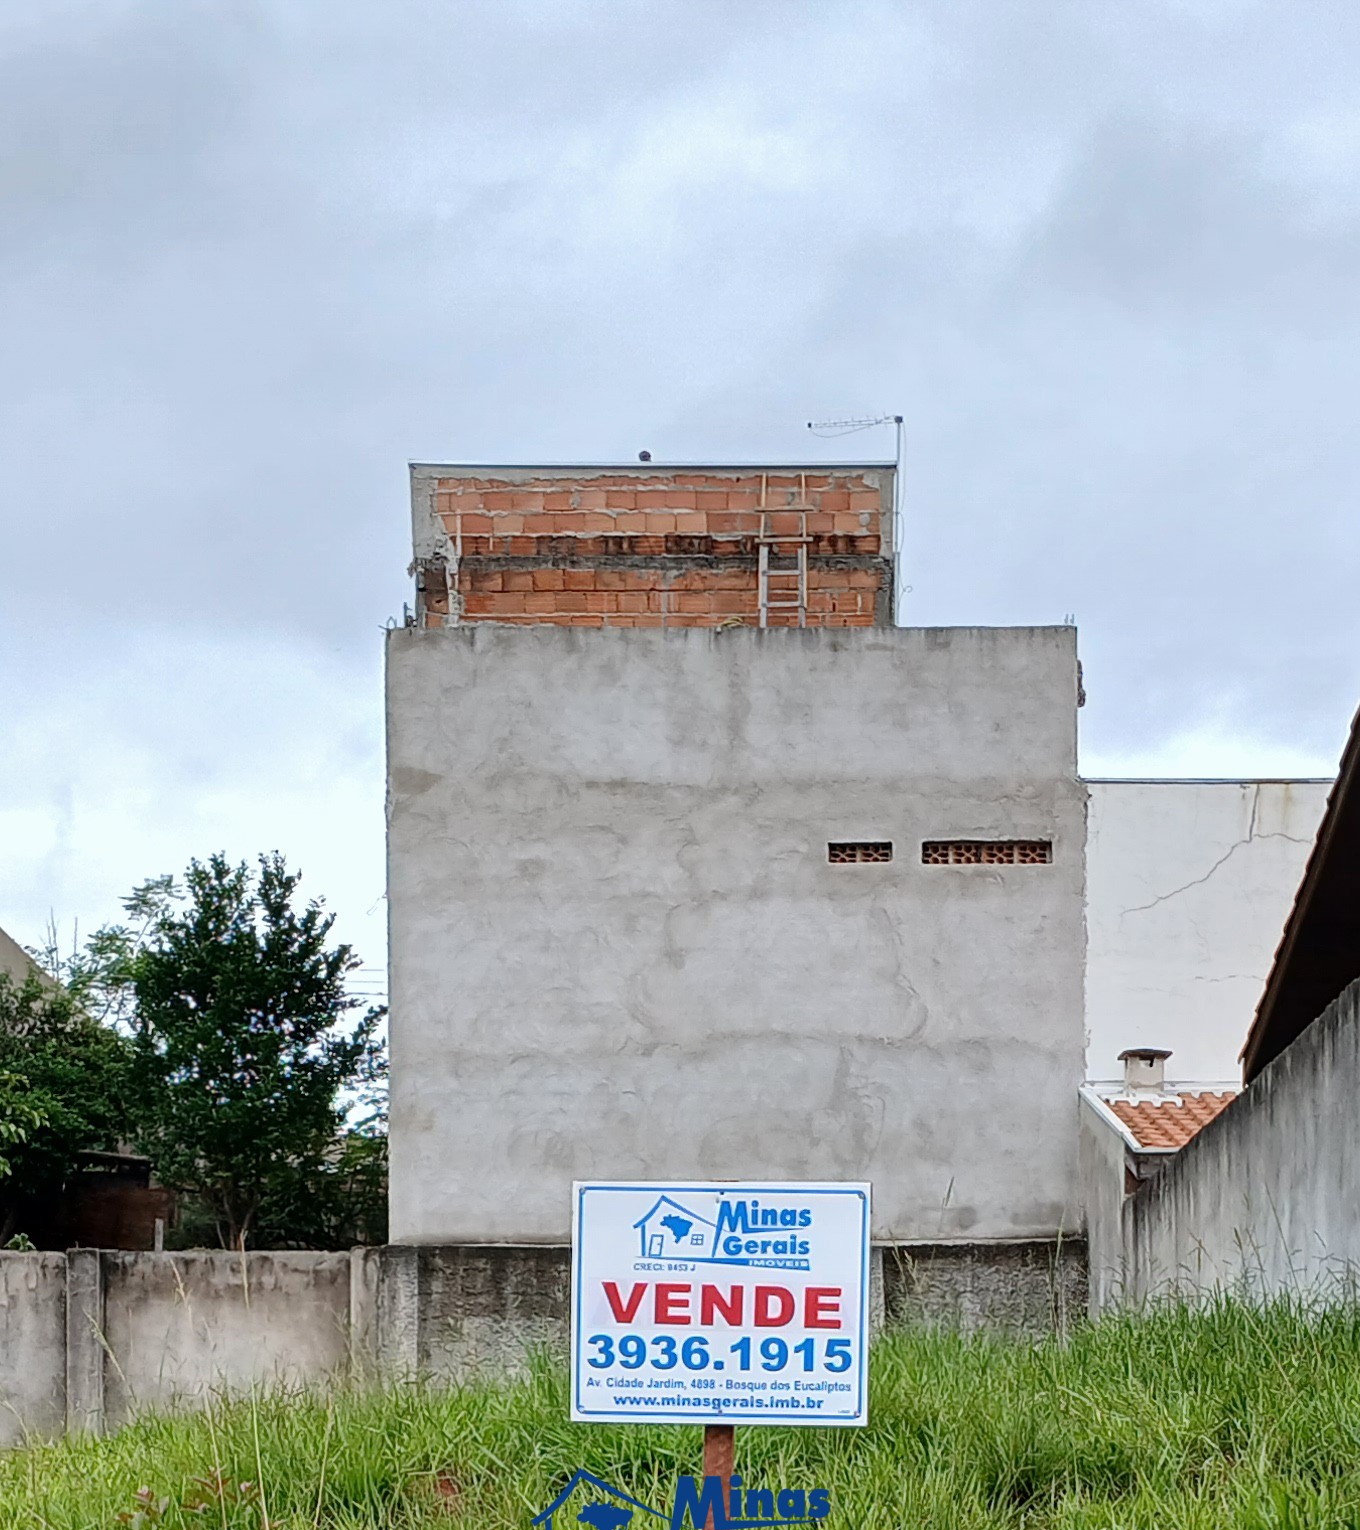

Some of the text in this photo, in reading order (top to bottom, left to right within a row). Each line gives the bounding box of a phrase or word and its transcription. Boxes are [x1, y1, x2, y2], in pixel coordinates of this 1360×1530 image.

[717, 1200, 812, 1233] Minas
[722, 1234, 811, 1256] Gerais
[601, 1281, 842, 1329] VENDE
[586, 1334, 852, 1372] 3936.1915
[606, 1377, 644, 1389] Cidade
[647, 1378, 687, 1390] Jardim,
[725, 1379, 768, 1392] Bosque
[770, 1380, 790, 1391] dos
[794, 1380, 852, 1394] Eucaliptos
[613, 1394, 825, 1410] www.minasgerais.imb.br
